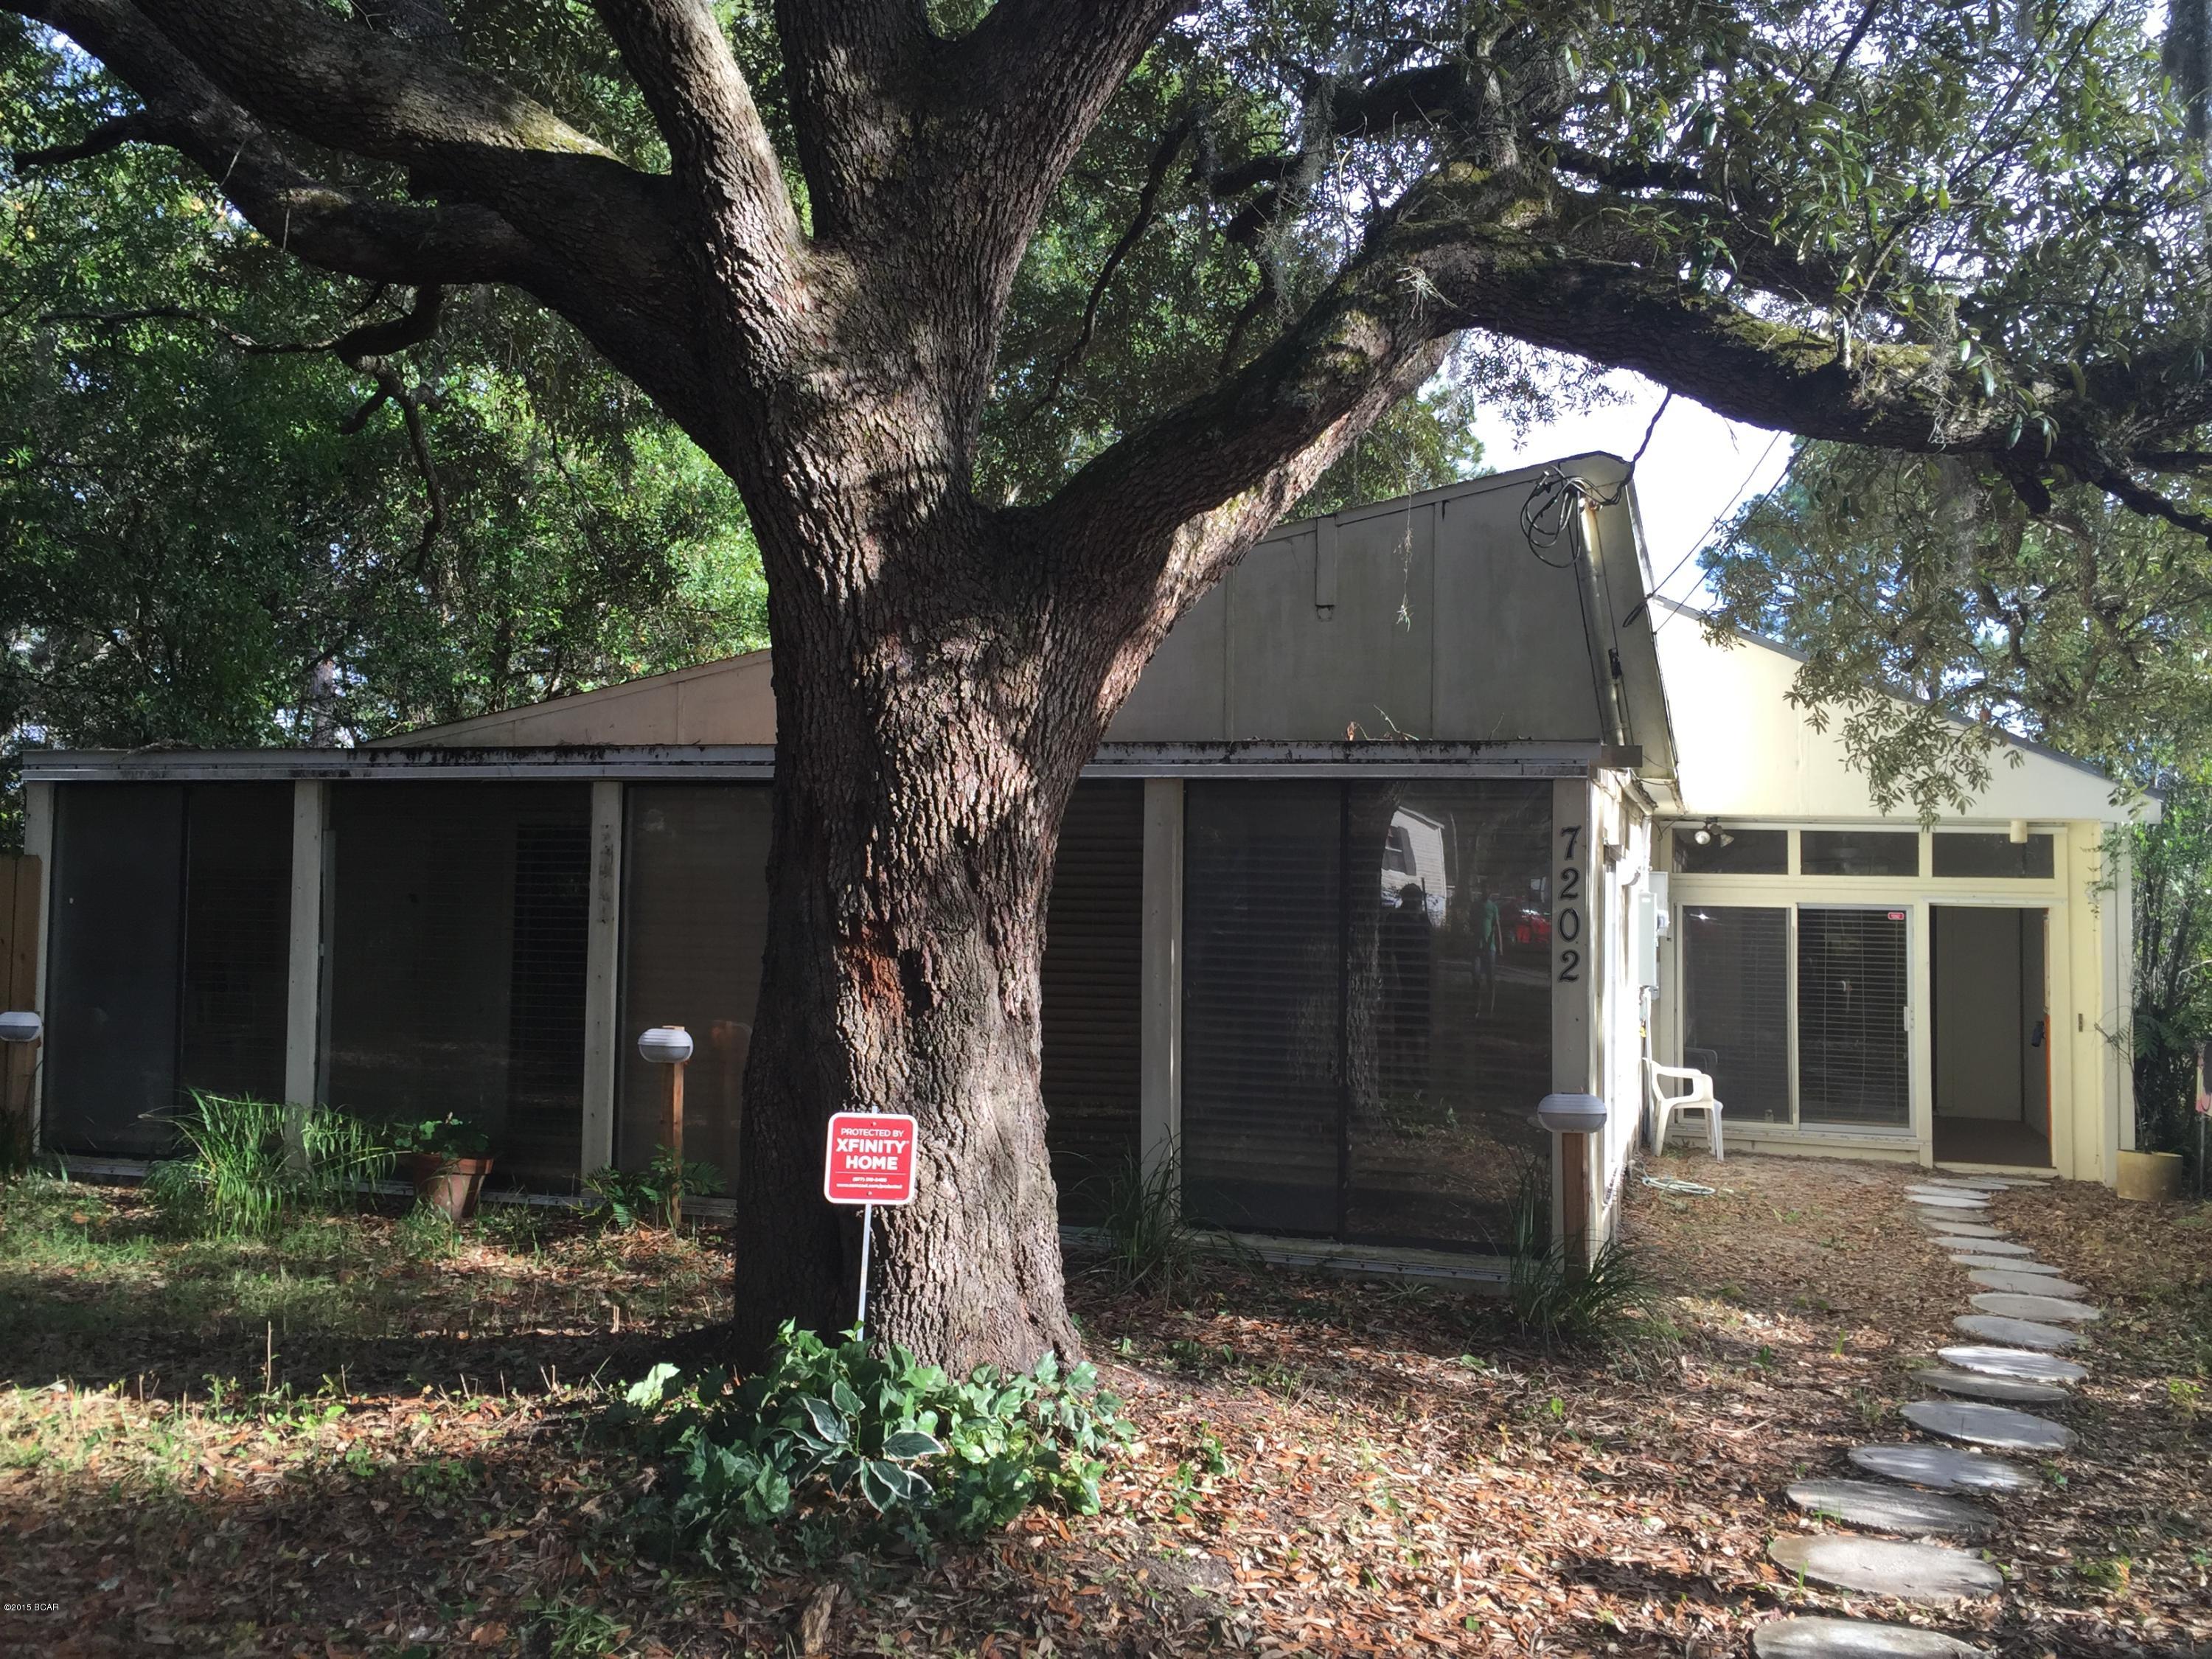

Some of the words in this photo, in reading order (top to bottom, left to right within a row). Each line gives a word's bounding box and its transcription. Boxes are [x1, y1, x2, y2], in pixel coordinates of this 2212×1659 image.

[1558, 825, 1582, 983] 7202
[841, 1128, 891, 1137] PROTECTED
[835, 1138, 906, 1154] XFINITY
[846, 1155, 898, 1170] HOME
